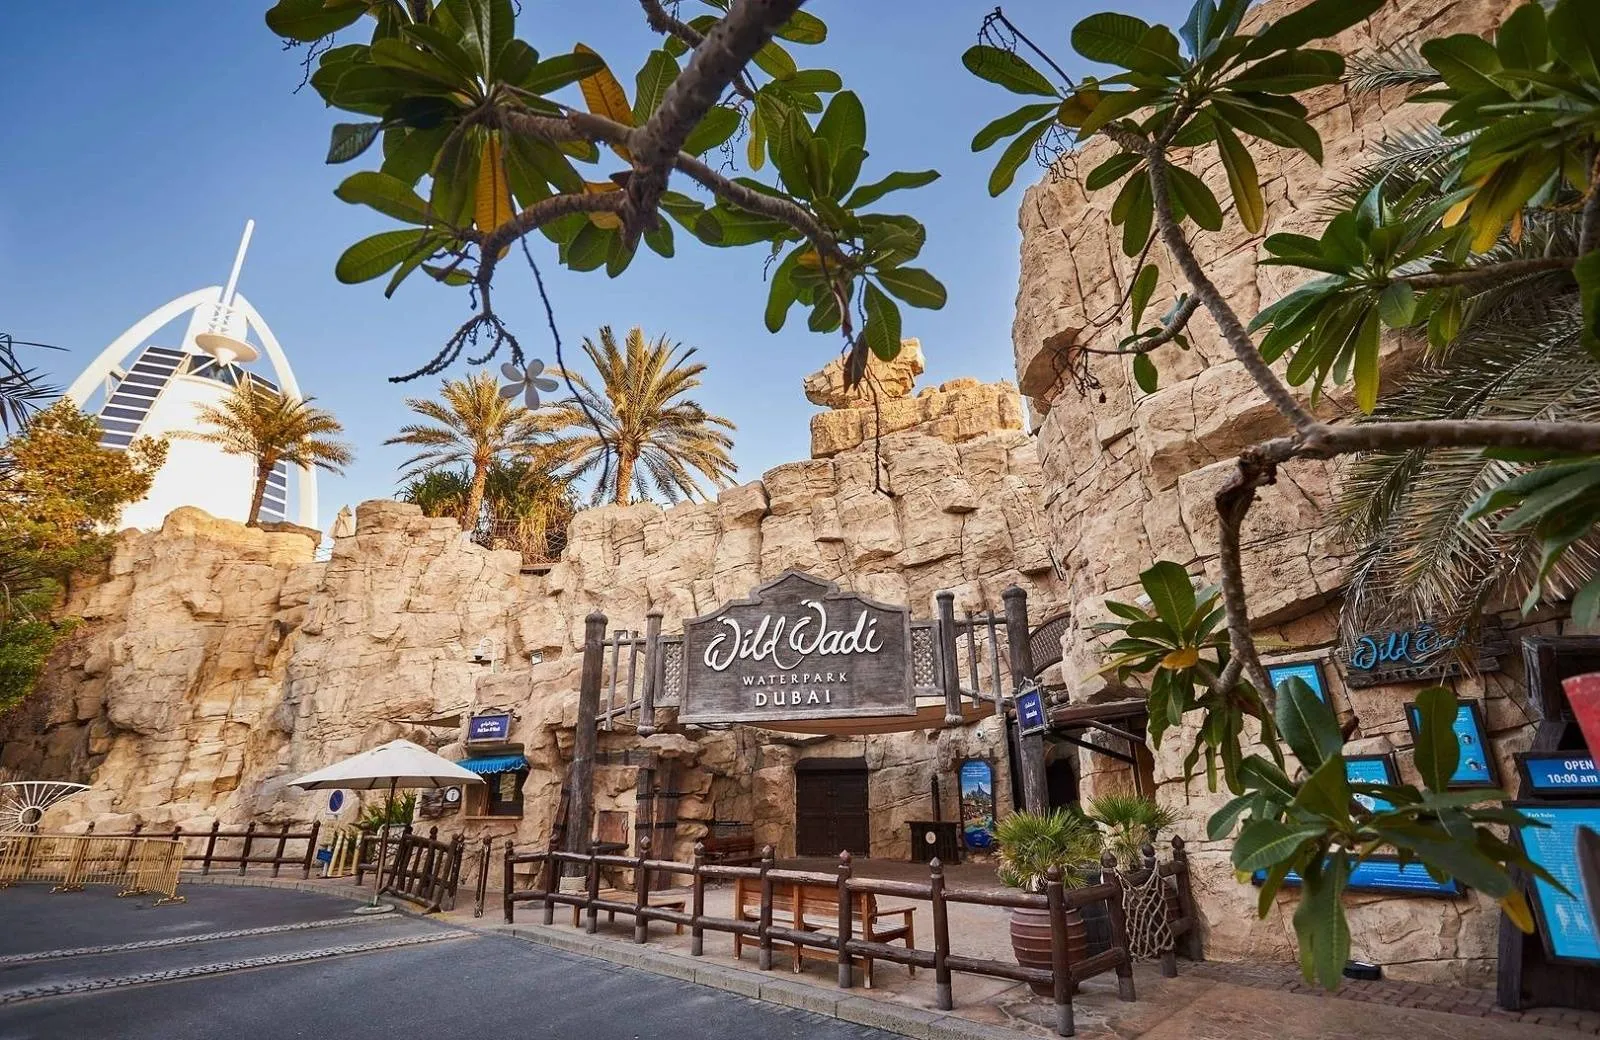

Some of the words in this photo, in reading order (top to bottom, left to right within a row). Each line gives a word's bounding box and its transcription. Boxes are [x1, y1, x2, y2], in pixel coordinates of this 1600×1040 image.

[704, 615, 804, 671] Wild
[789, 600, 884, 655] Wadi
[1353, 632, 1415, 669] Wild
[743, 672, 848, 686] WATERPARK
[755, 689, 832, 707] DUBAI
[1564, 760, 1595, 770] OPEN
[1547, 773, 1578, 783] 10:00
[1580, 775, 1598, 783] am
